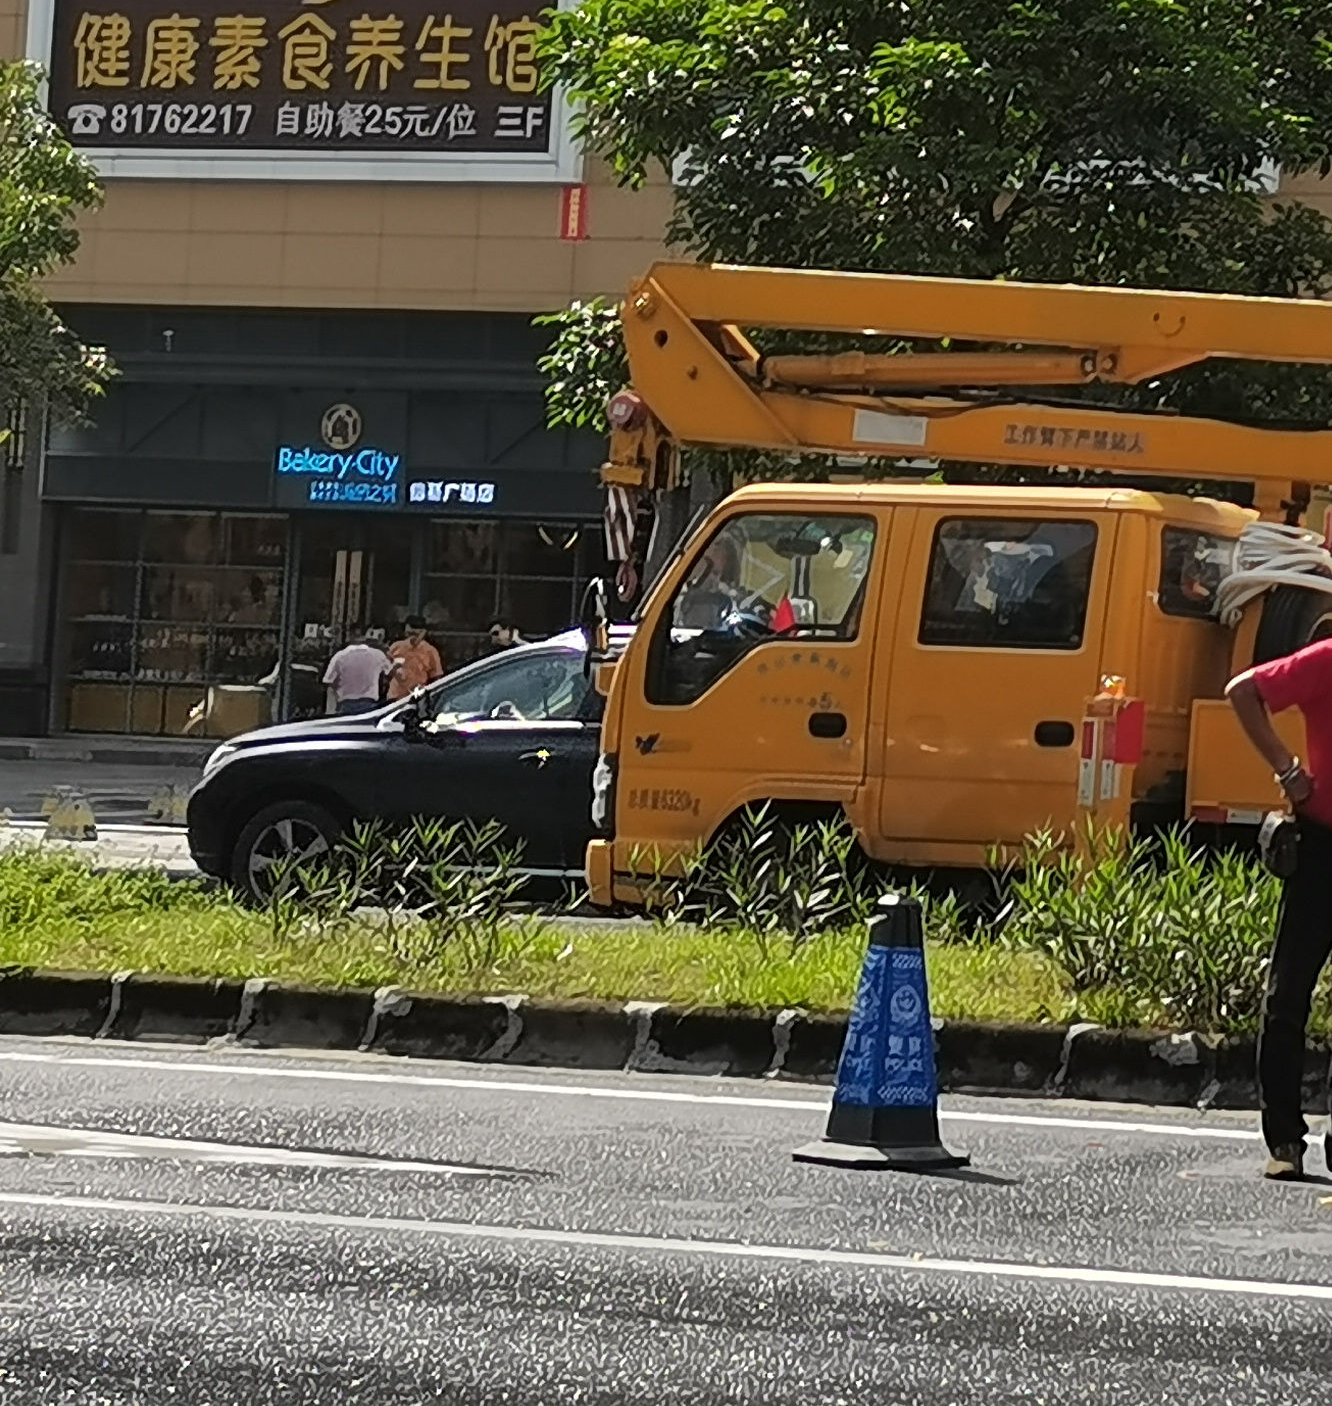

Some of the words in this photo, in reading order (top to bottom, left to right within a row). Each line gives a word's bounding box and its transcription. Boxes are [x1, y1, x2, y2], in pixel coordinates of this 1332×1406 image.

[74, 12, 542, 93] 健康素食养生馆
[110, 103, 253, 135] 81762217
[275, 100, 477, 139] 自助餐25元/位
[494, 106, 545, 139] 三F
